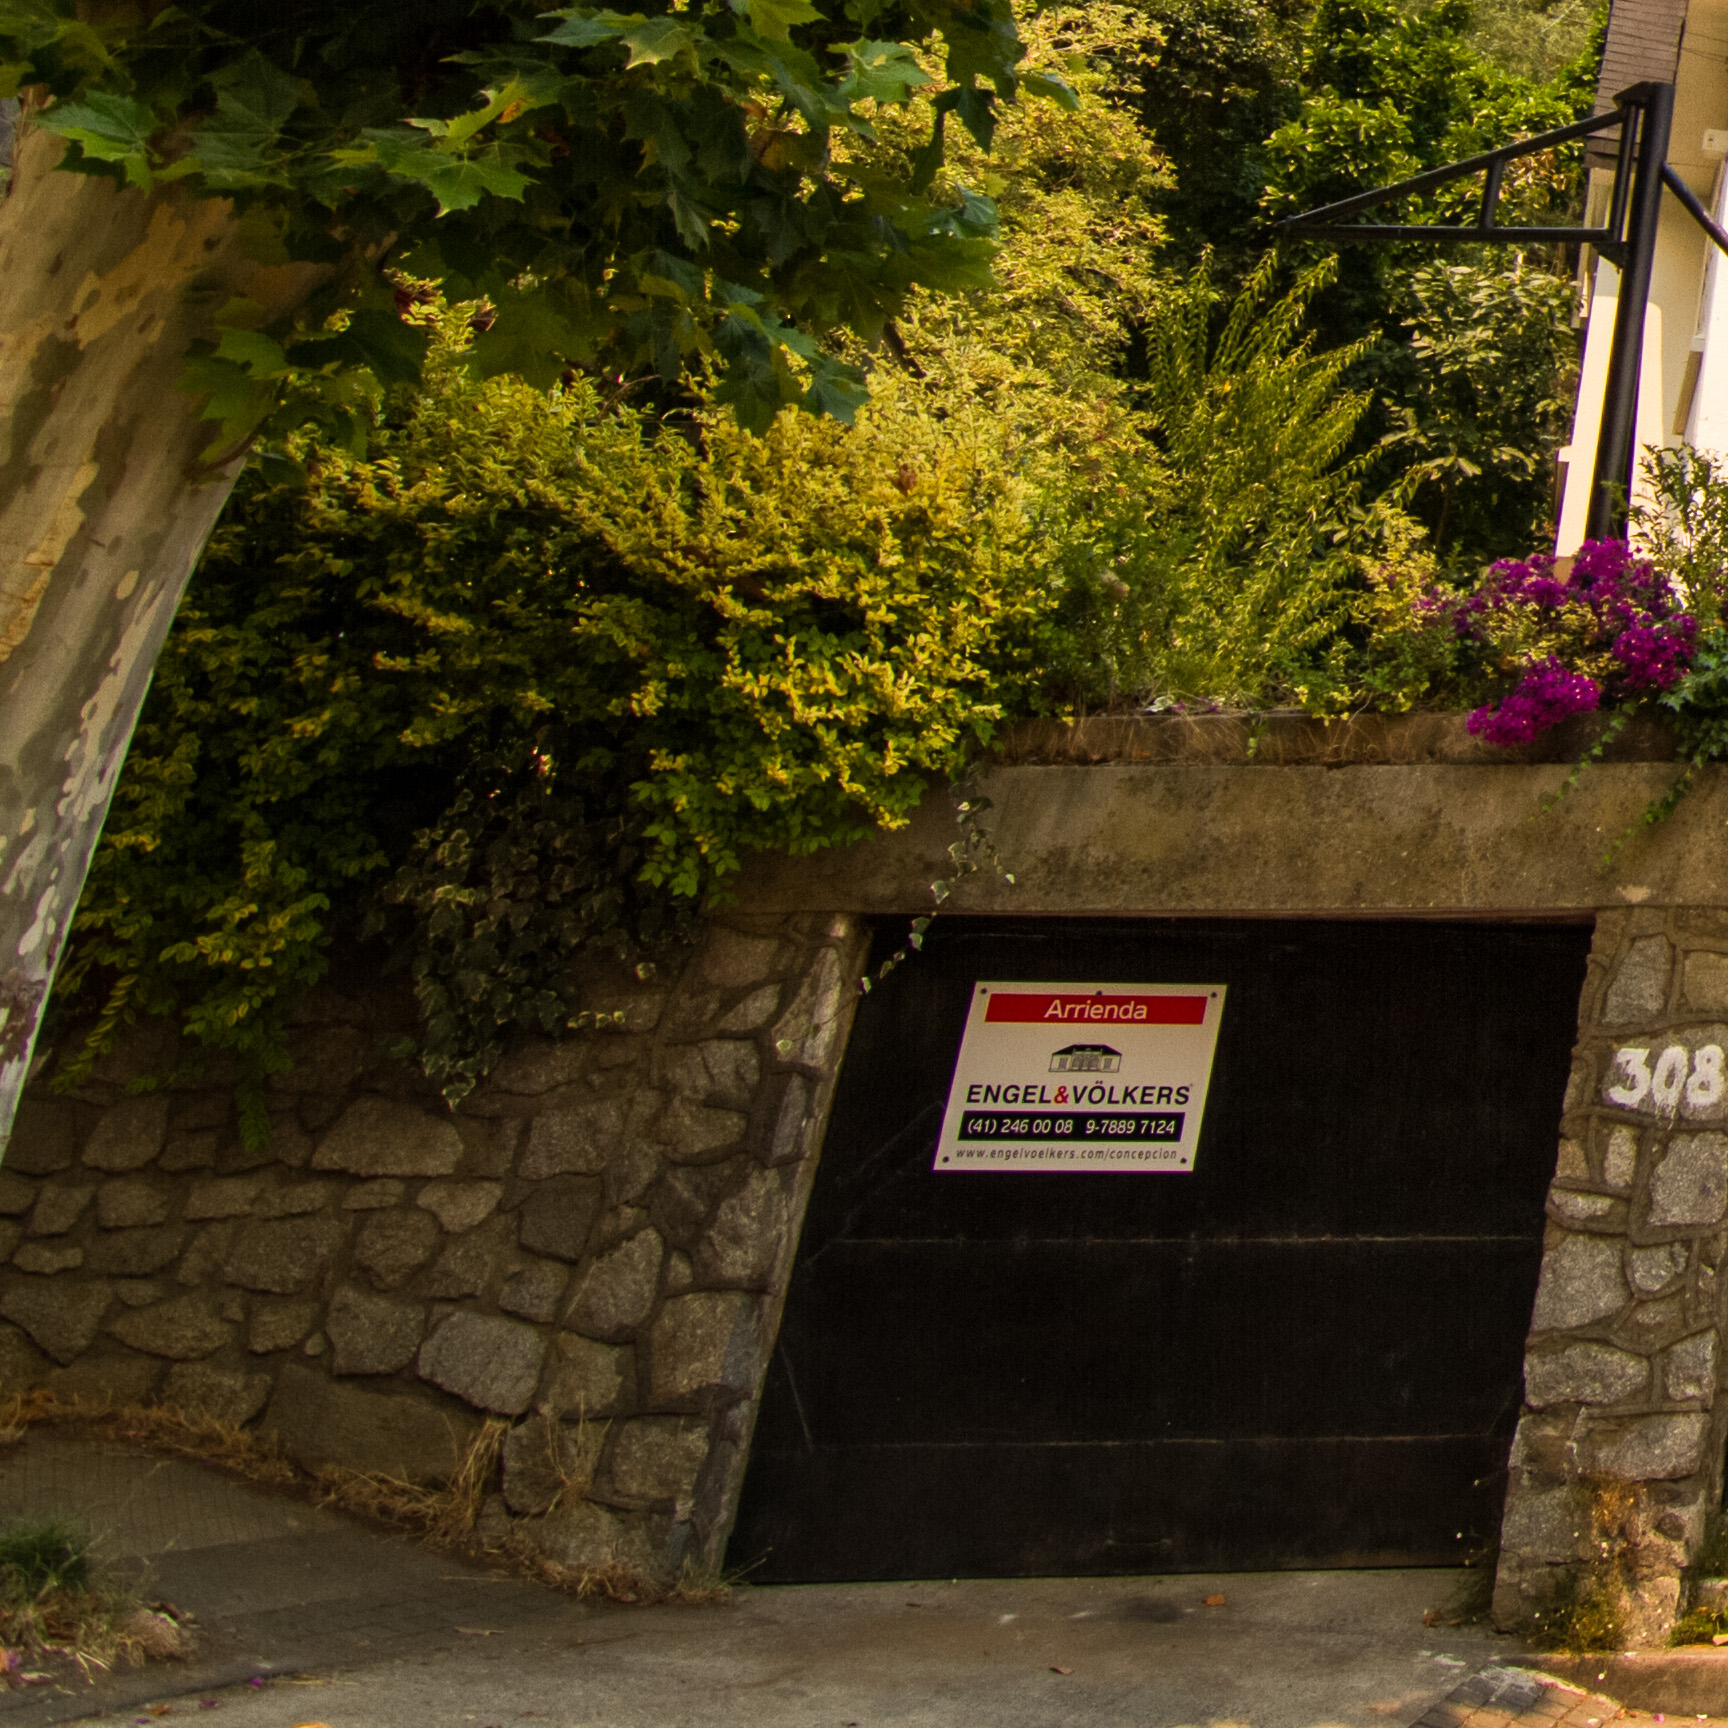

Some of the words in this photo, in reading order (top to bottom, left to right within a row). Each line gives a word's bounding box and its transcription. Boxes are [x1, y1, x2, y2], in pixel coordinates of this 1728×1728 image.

[1044, 999, 1148, 1020] Arrienda
[1607, 1044, 1725, 1108] 308
[966, 1080, 1190, 1105] ENGEL&VÖLKERS
[967, 1119, 996, 1134] (41)
[1001, 1119, 1029, 1134] 246
[1032, 1119, 1052, 1134] 00
[1054, 1119, 1074, 1134] 08
[1085, 1120, 1135, 1134] 9-7889
[1140, 1120, 1175, 1134] 7124
[956, 1147, 1178, 1161] www.engelvoelkers.com/concepcion
